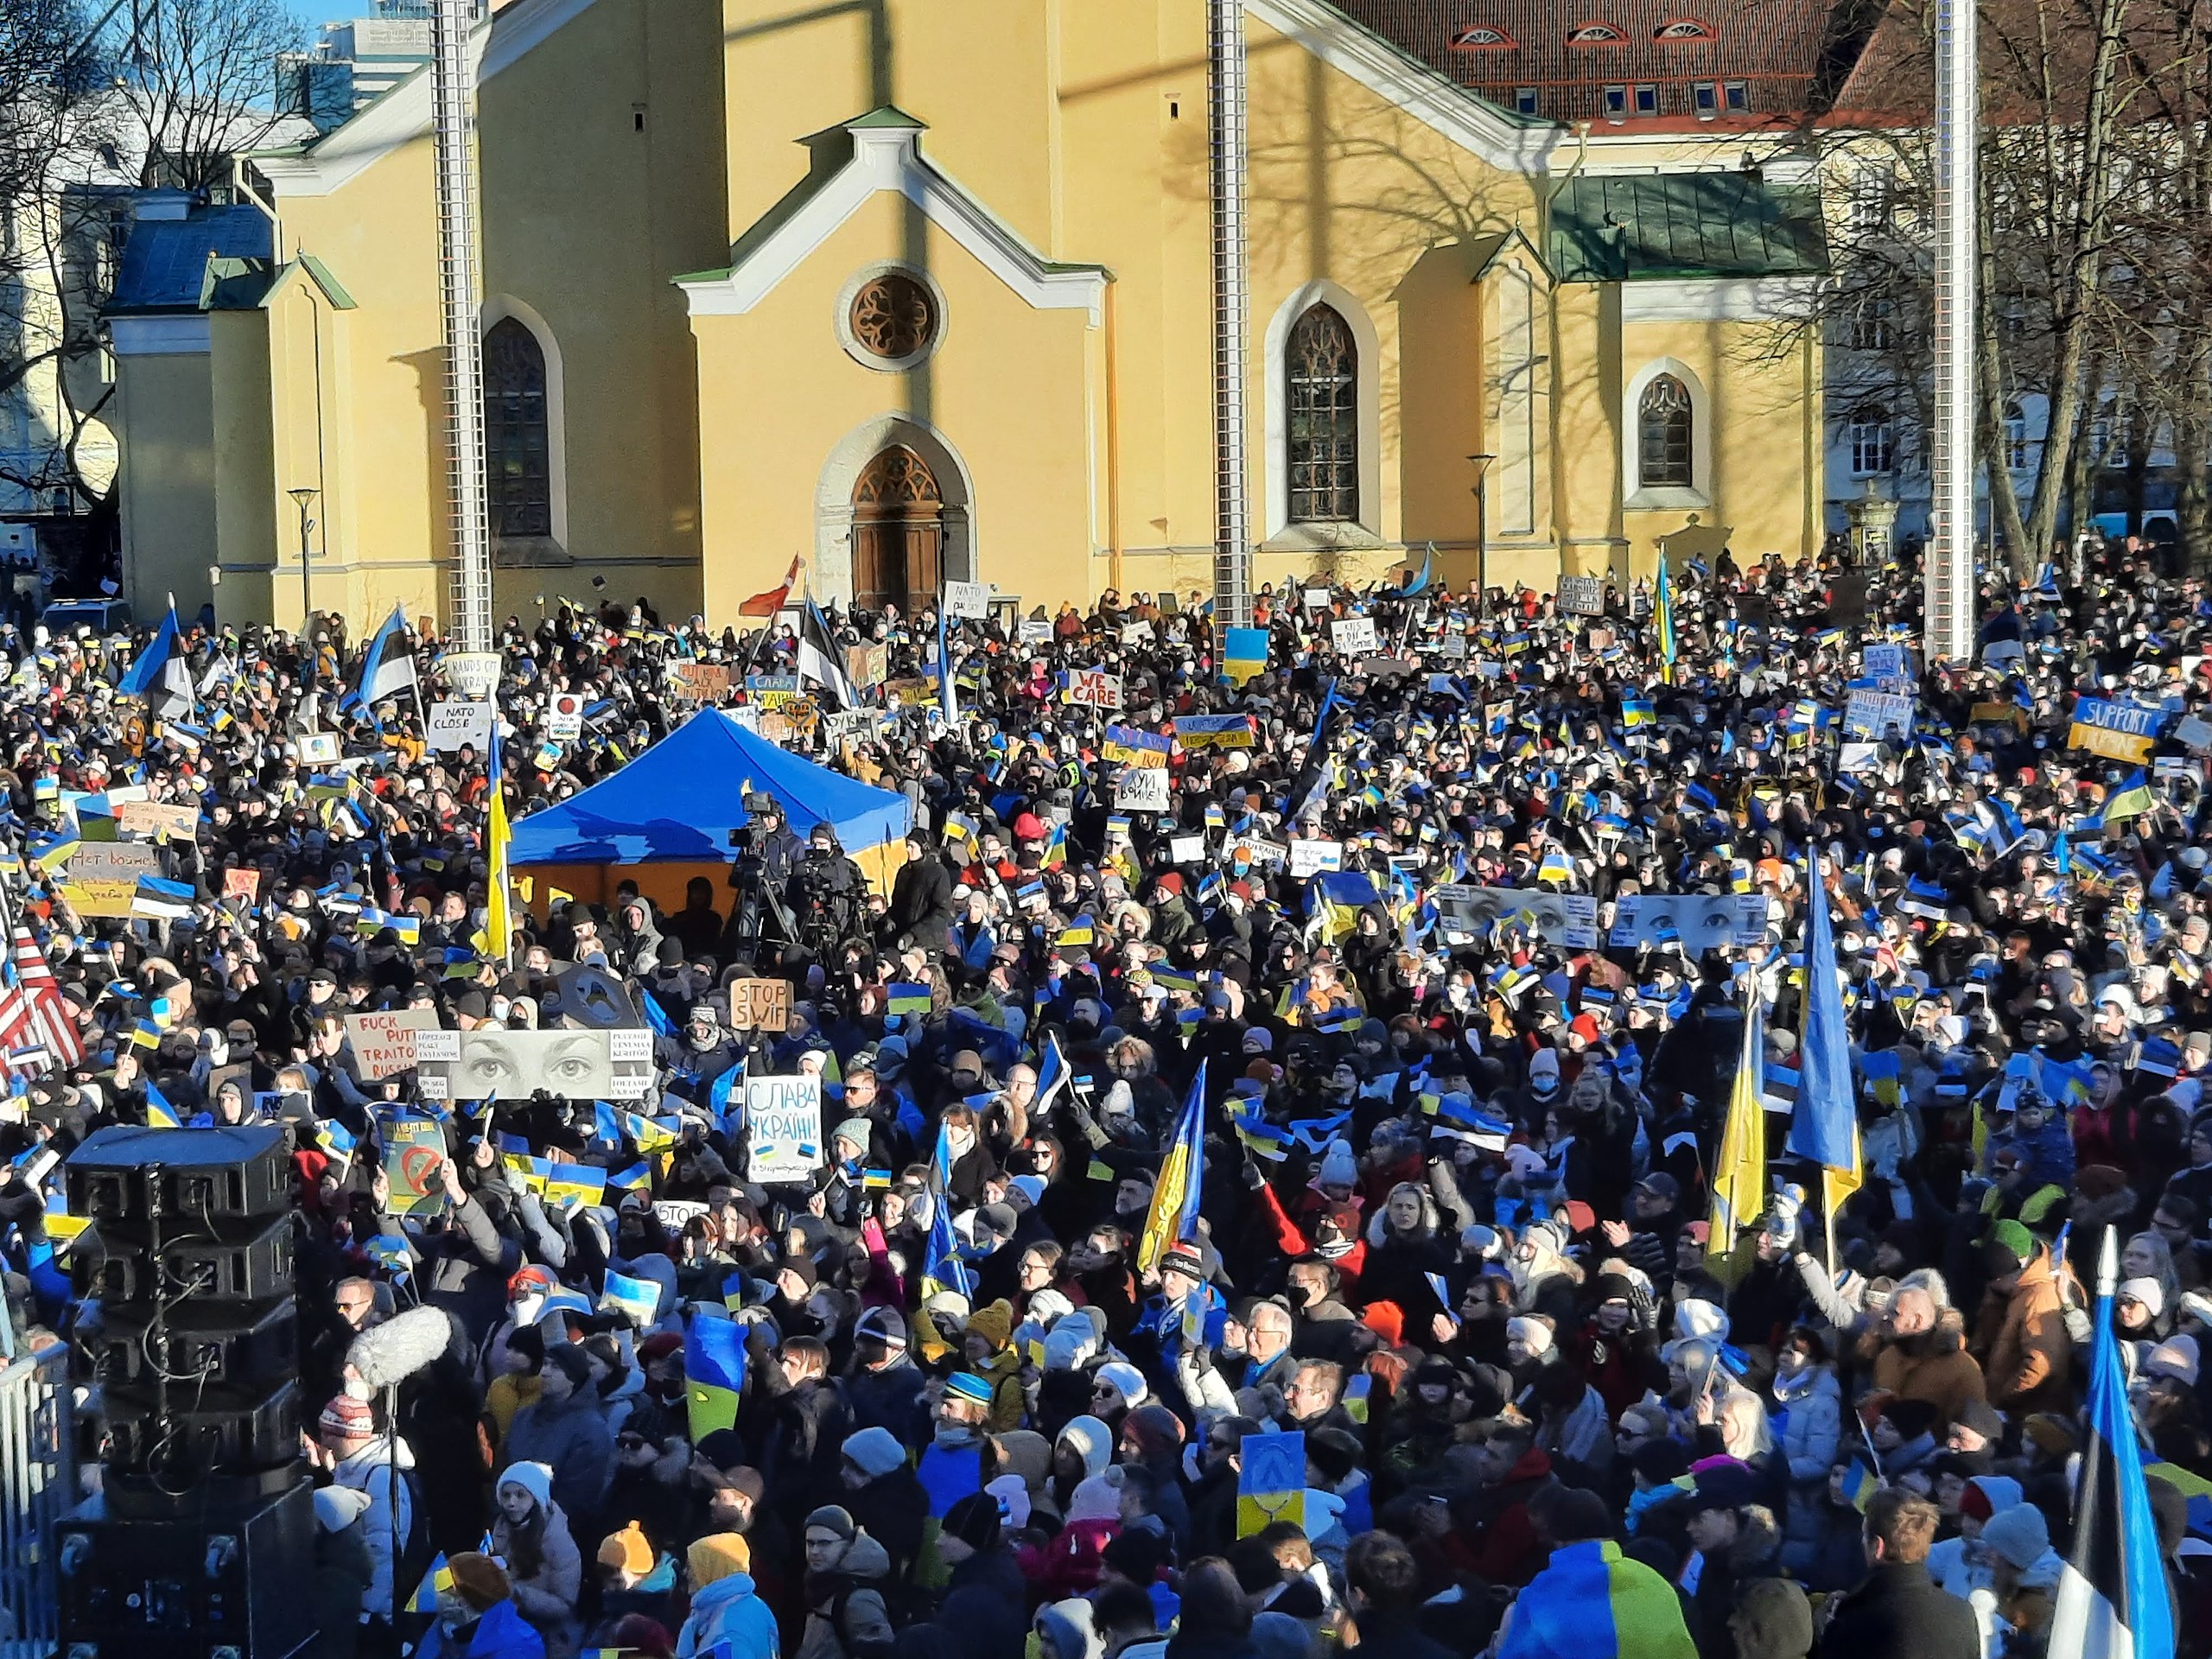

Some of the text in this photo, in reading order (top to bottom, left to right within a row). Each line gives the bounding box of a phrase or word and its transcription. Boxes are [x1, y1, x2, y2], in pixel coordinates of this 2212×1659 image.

[955, 585, 981, 596] NATO
[1078, 671, 1106, 689] WE
[1073, 686, 1116, 706] CARE
[446, 707, 474, 718] NATO
[2084, 702, 2152, 734] SUPPORT
[435, 718, 469, 729] CLOSE
[738, 985, 786, 1003] STOP
[359, 1016, 399, 1031] FUCK
[749, 1082, 819, 1111] СЛАВА
[748, 1111, 817, 1141] УКРАЇНІ!
